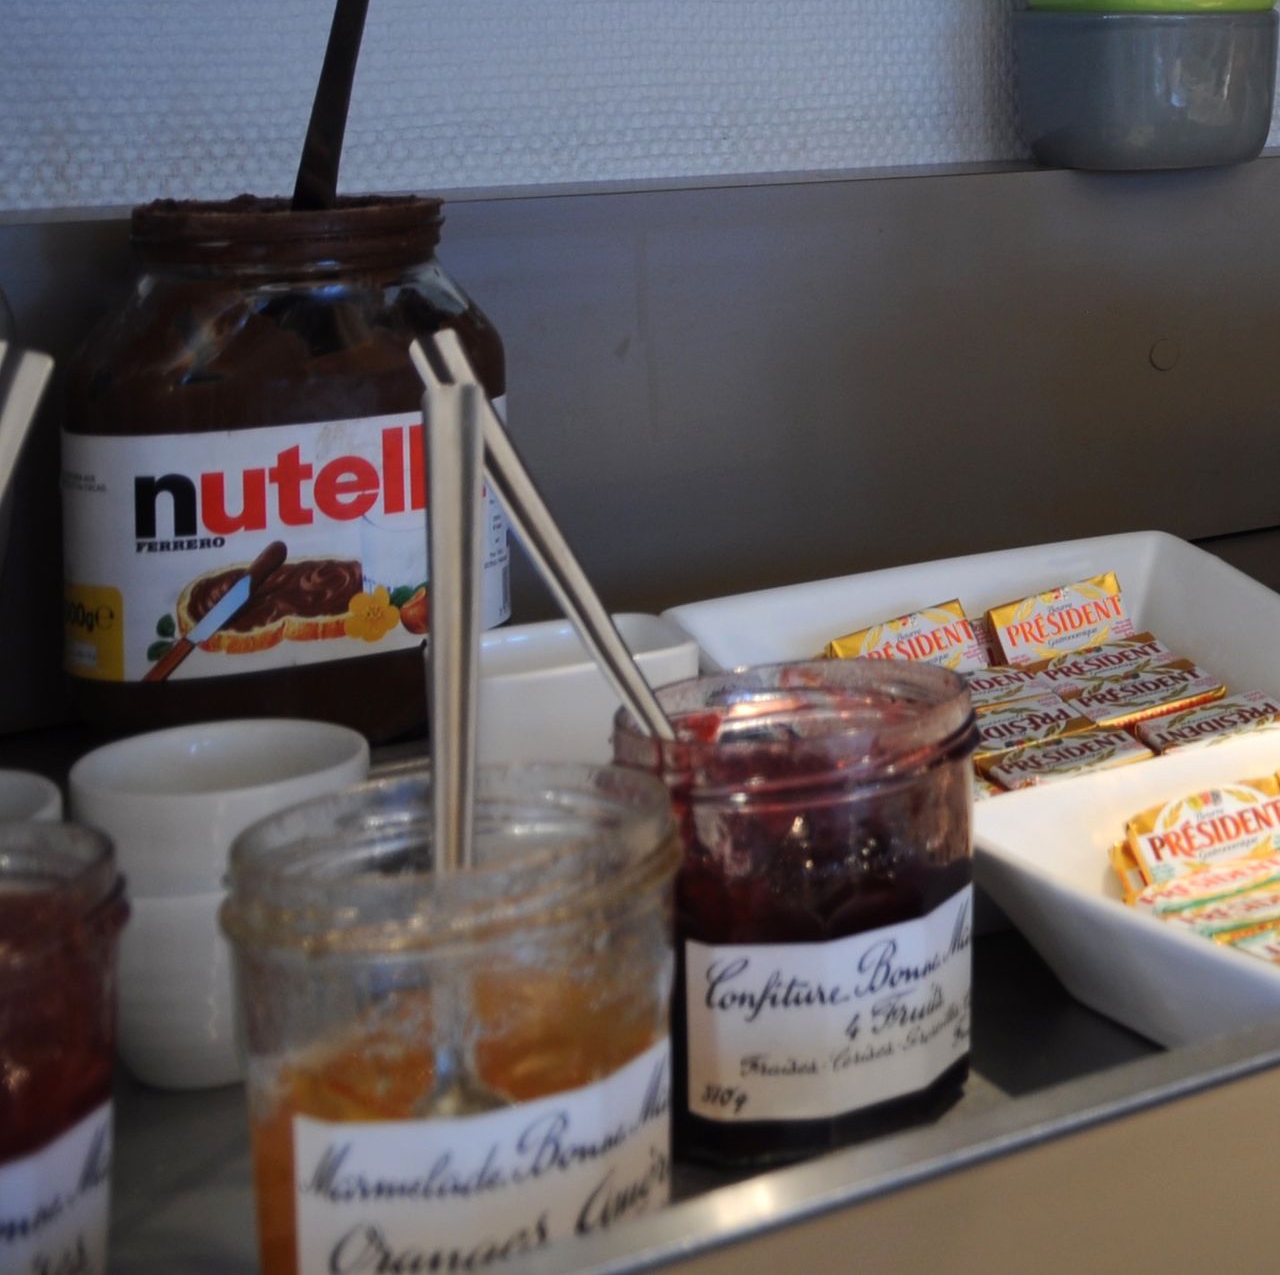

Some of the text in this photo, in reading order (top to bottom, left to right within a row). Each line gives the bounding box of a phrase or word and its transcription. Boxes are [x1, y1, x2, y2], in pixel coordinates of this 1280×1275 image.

[134, 423, 428, 541] nutell
[135, 536, 226, 554] FERRERO
[1006, 594, 1122, 648] PRÉSIDENT
[704, 957, 848, 1023] Confiture
